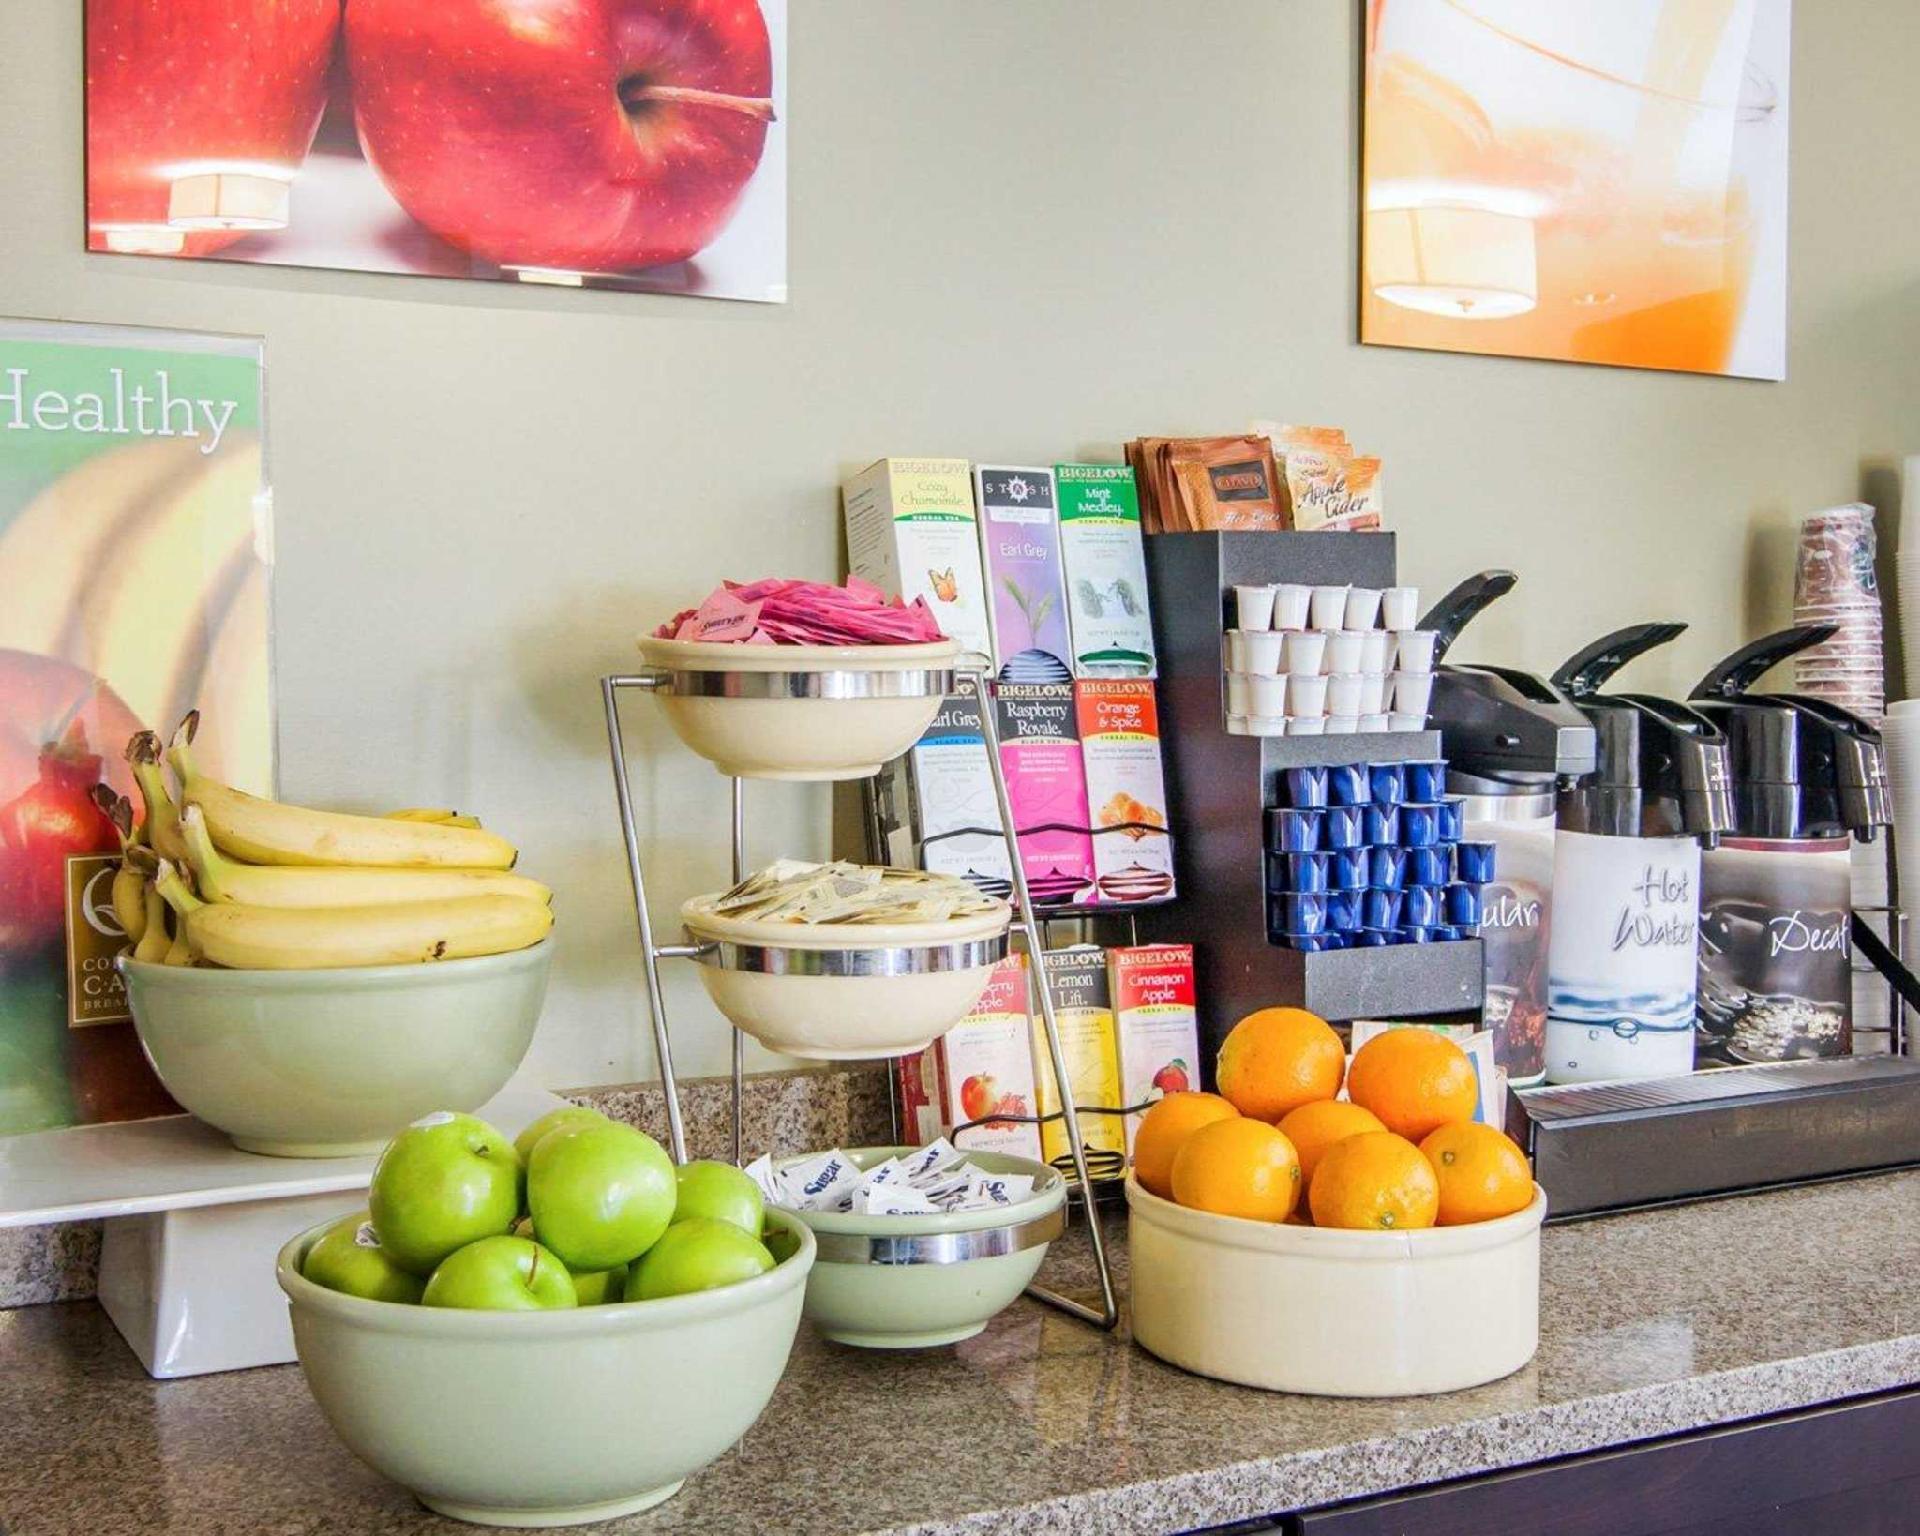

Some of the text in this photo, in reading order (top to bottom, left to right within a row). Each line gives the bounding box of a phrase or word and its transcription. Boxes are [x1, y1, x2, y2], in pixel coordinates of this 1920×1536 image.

[0, 368, 238, 454] Healthy
[1060, 467, 1133, 479] BIGELOW
[1085, 487, 1111, 500] Mint
[1325, 493, 1369, 519] Cider
[1000, 542, 1022, 556] Earl
[998, 684, 1072, 697] BIGELOW
[1081, 682, 1151, 694] BIGELOW
[1006, 701, 1068, 721] Raspberry
[1095, 701, 1141, 718] Orange
[1111, 716, 1142, 732] Spice
[1632, 863, 1690, 907] Hot
[1477, 895, 1539, 935] ular
[1612, 905, 1695, 951] Water
[1769, 910, 1848, 960] Decaf
[1043, 951, 1106, 967] IGELOW
[1120, 950, 1192, 965] BIGELOW
[1049, 972, 1094, 989] Lemon
[1128, 973, 1185, 988] Cinnamon
[1140, 985, 1176, 1004] Apple
[803, 1159, 842, 1195] Sugar
